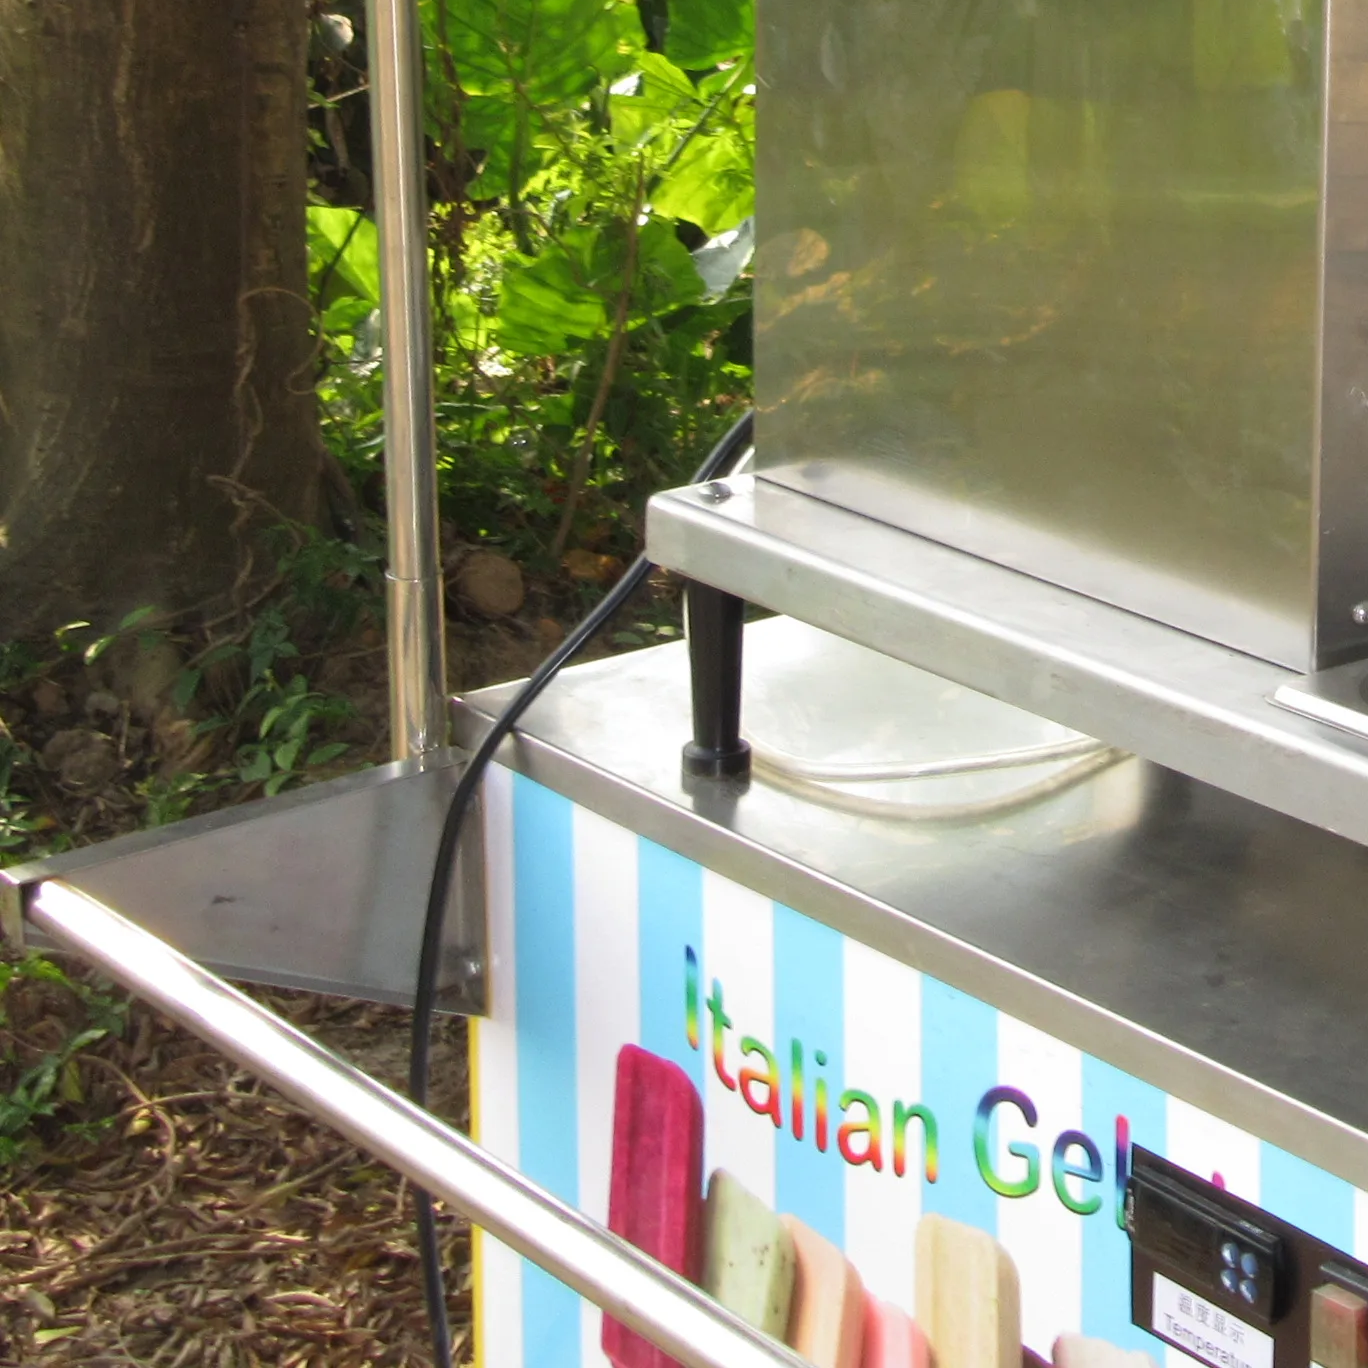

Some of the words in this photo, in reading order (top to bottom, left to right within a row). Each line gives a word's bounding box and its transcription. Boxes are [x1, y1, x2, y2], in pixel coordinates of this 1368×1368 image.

[685, 943, 939, 1184] Italian
[1178, 1292, 1245, 1346] 温度显示
